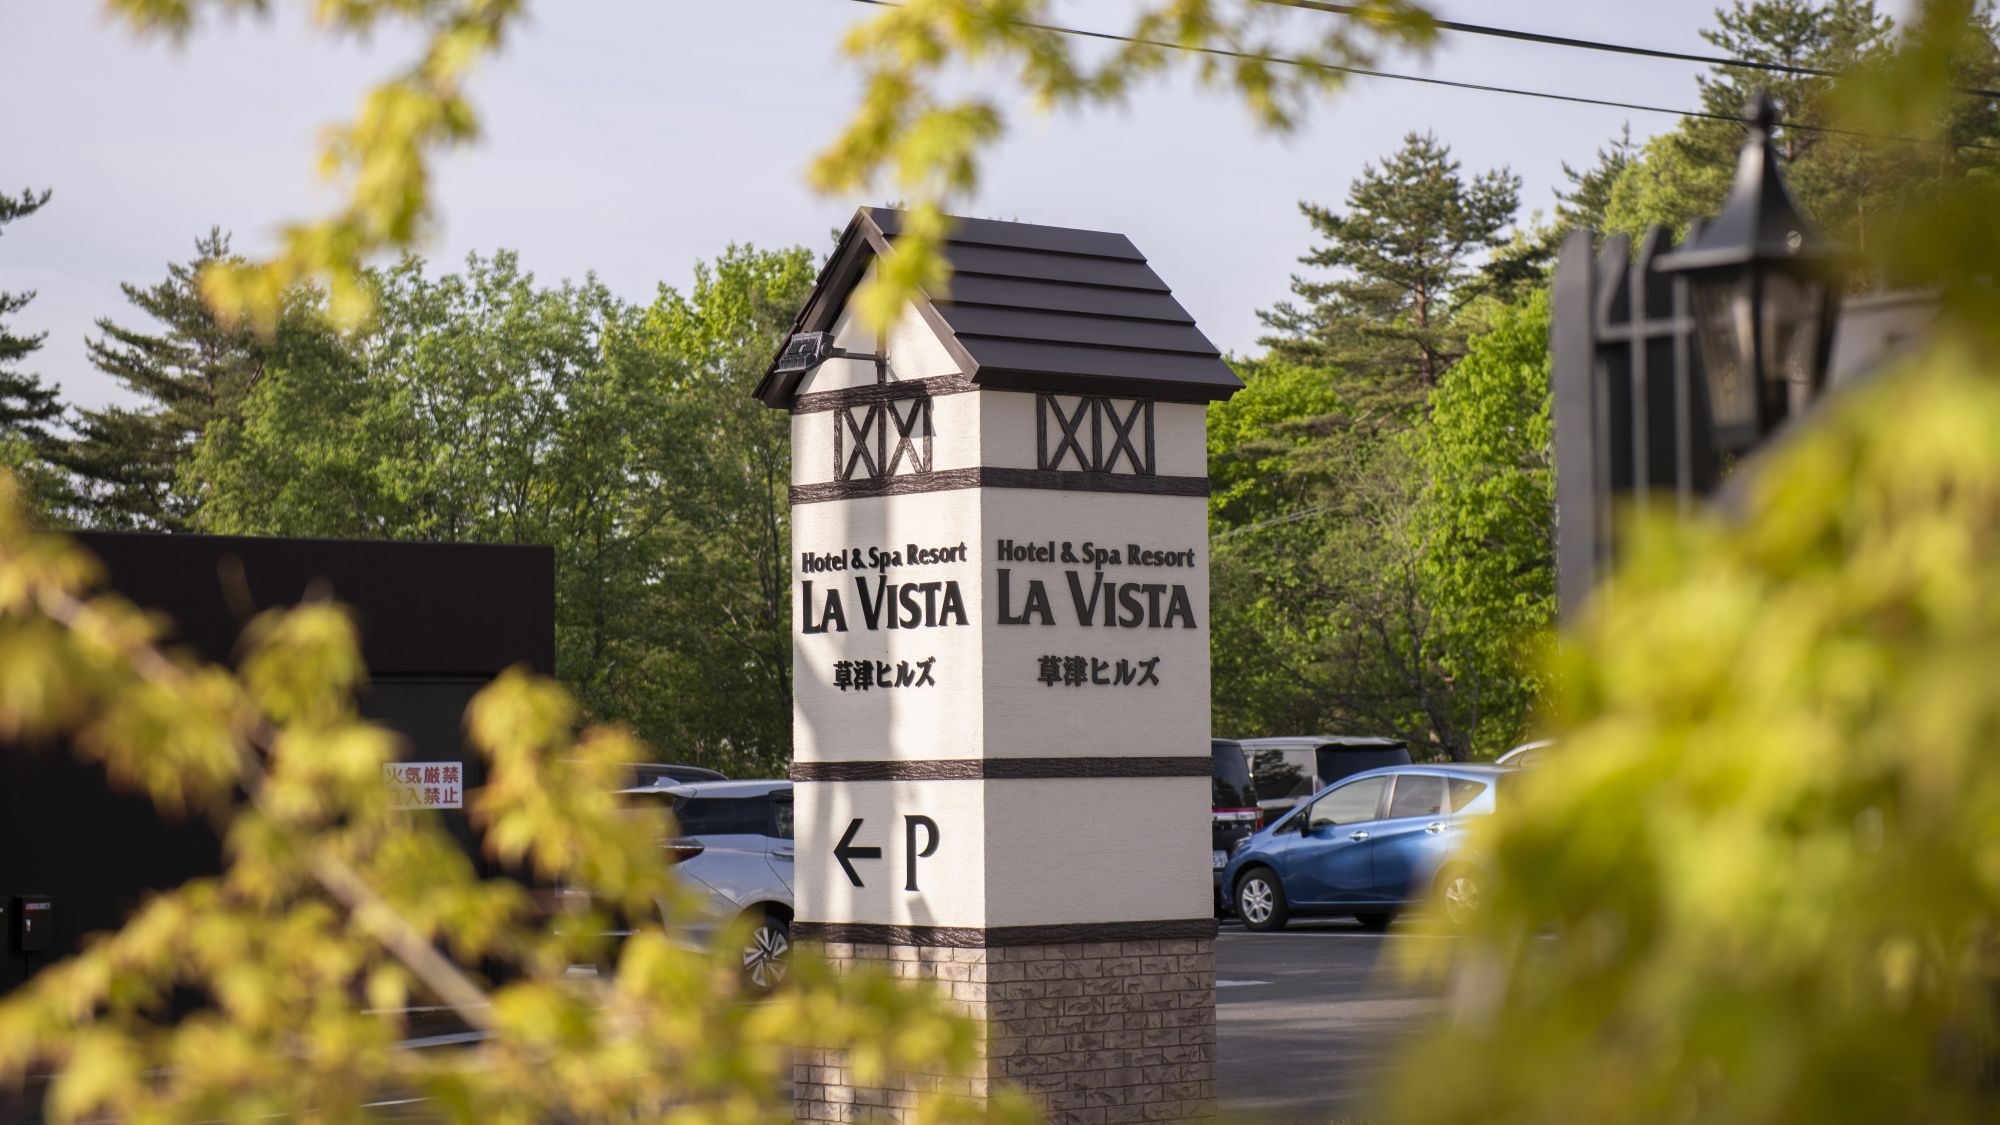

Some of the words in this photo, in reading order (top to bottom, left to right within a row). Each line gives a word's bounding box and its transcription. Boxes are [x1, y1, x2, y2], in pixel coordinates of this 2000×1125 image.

[801, 549, 848, 573] Hotel
[851, 548, 868, 569] &
[868, 546, 903, 573] Spa
[906, 541, 967, 565] Resort
[997, 539, 1055, 562] Hotel
[1061, 541, 1080, 563] &
[1082, 542, 1122, 569] Spa
[1127, 544, 1195, 567] Resort
[801, 580, 848, 634] LA
[855, 575, 970, 630] VISTA
[997, 569, 1056, 625] LA
[1065, 570, 1198, 628] VISTA
[833, 657, 936, 691] 草津ヒルズ
[1038, 655, 1160, 687] 草津ヒルズ
[387, 766, 459, 784] 火気厳禁
[904, 815, 940, 891] P
